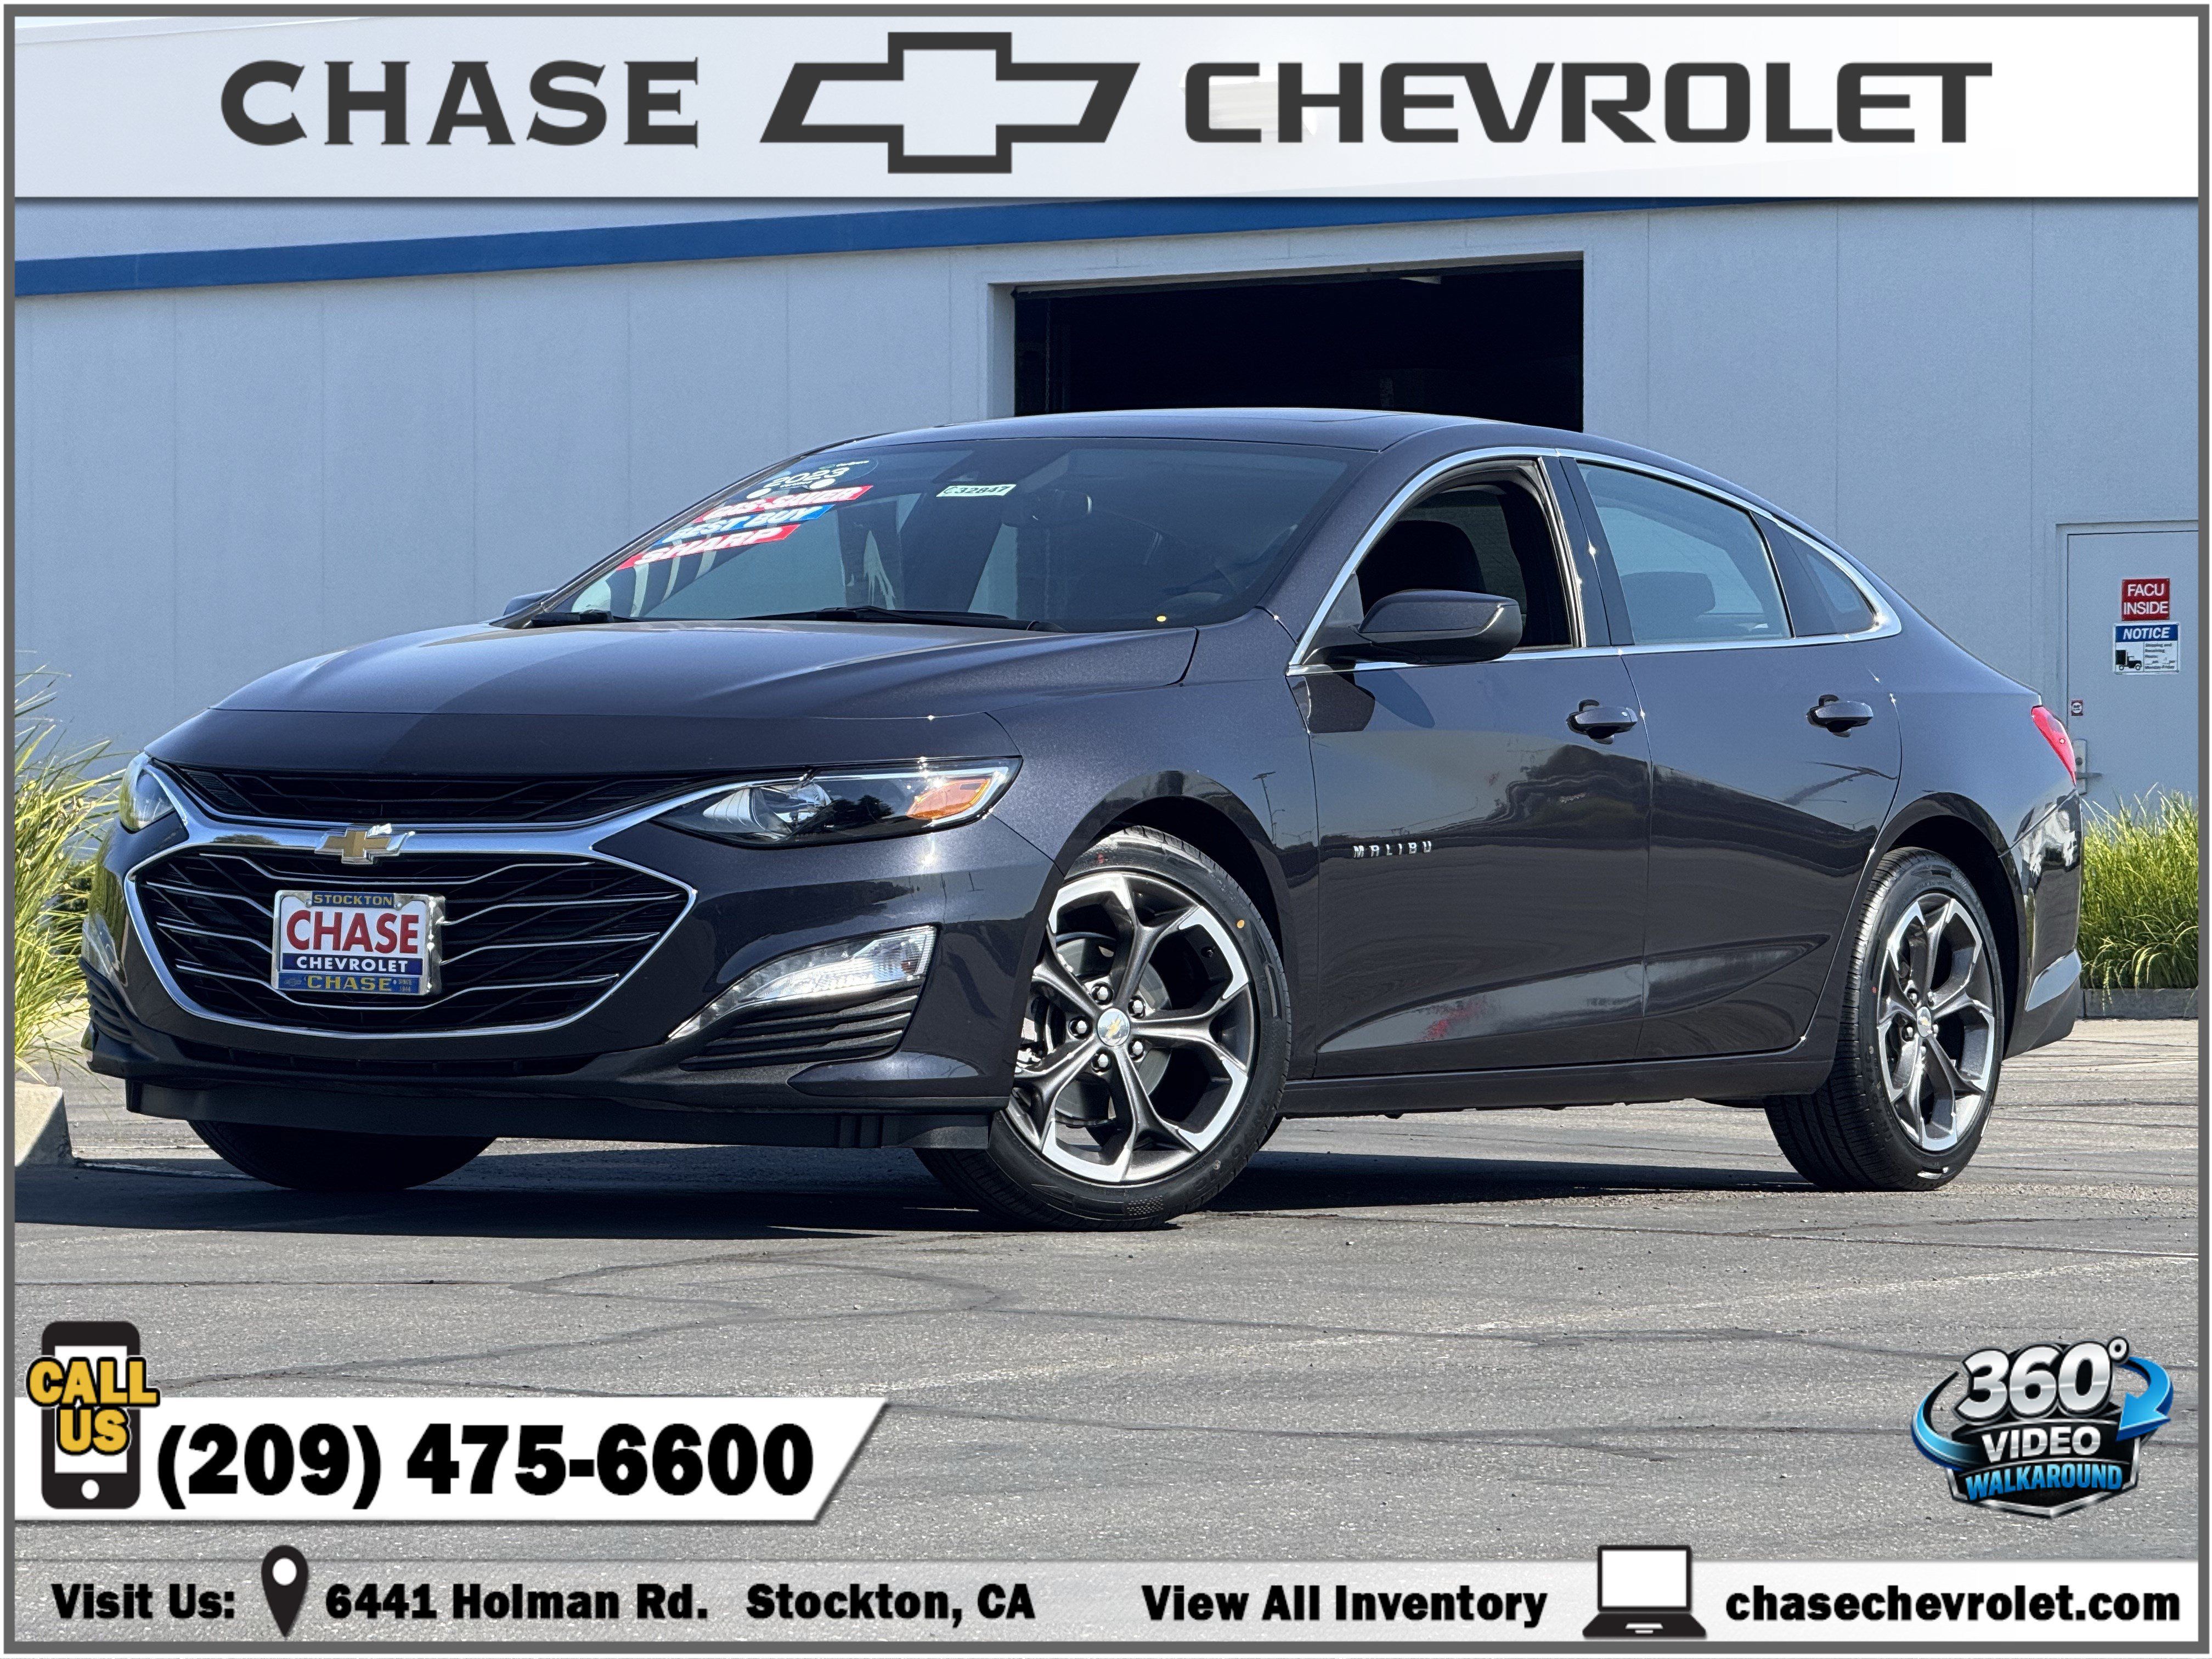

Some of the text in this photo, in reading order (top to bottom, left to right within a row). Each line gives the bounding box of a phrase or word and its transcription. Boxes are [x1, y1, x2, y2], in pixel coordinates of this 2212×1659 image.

[763, 466, 850, 489] 2023
[662, 505, 824, 544] BEST BUY
[634, 527, 783, 565] SHARP
[2128, 583, 2164, 597] FACU
[2124, 601, 2169, 615] INSIDE
[2123, 627, 2171, 640] NOTICE
[1353, 840, 1432, 859] MALIBU
[313, 894, 393, 906] STOCKTON
[286, 910, 419, 954] CHASE
[296, 956, 408, 973] CHEVROLET
[307, 975, 392, 992] CHASE
